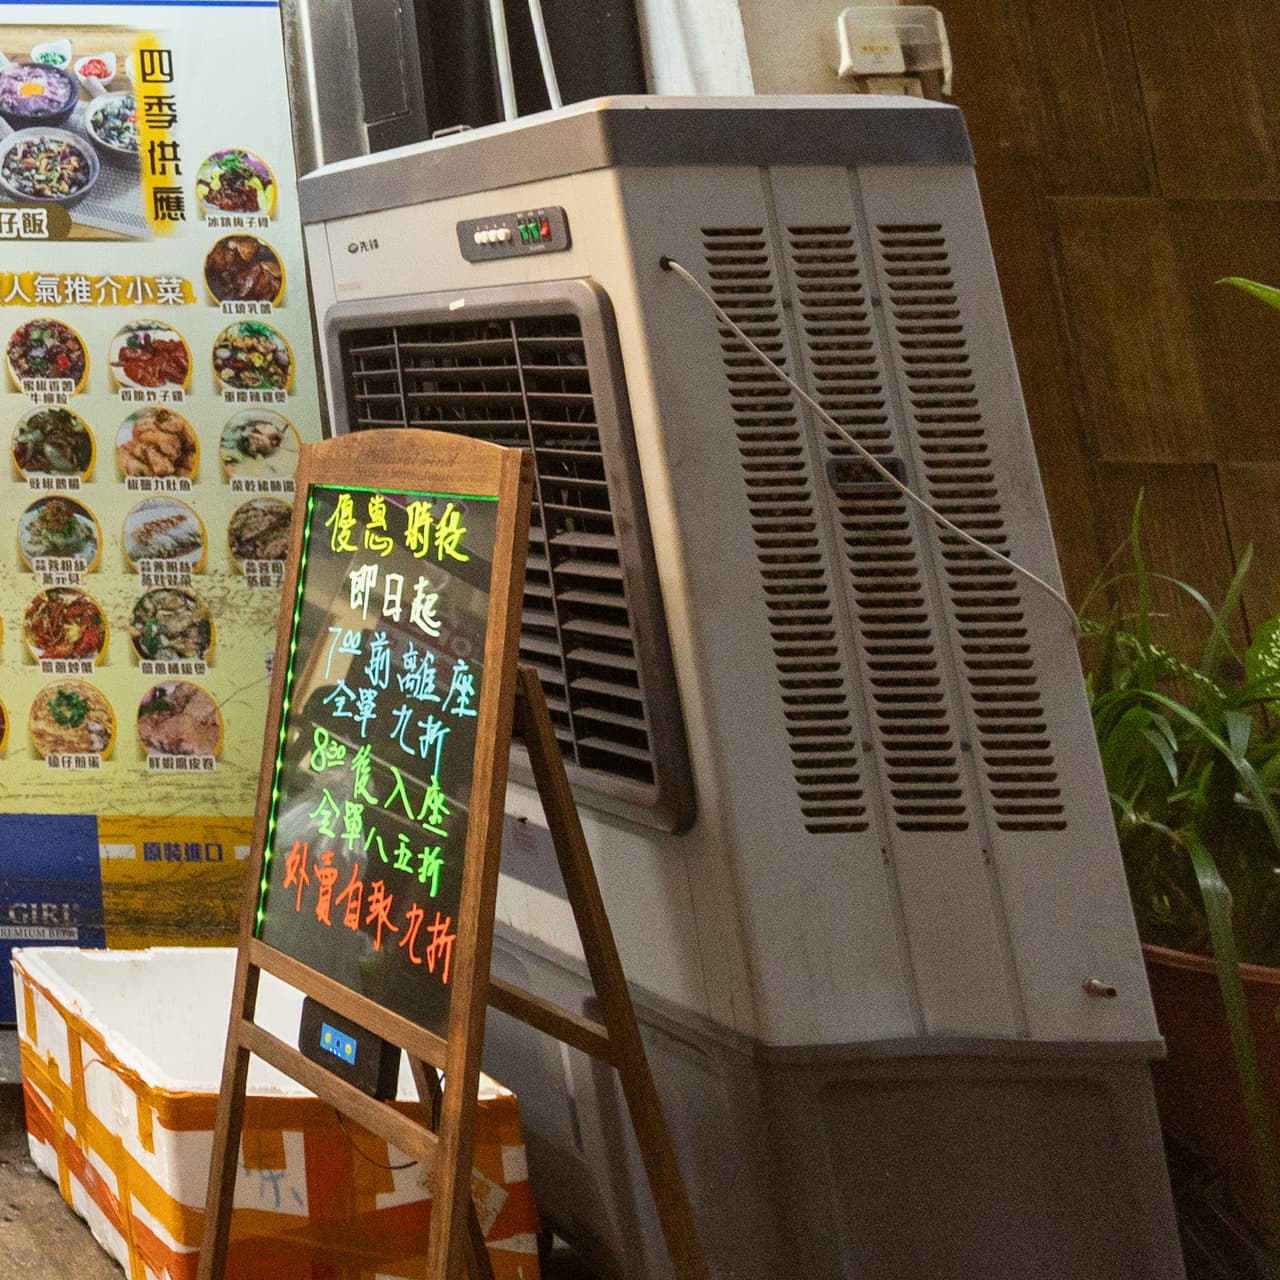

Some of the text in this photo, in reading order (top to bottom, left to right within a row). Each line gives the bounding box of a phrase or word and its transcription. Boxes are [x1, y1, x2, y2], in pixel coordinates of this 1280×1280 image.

[139, 49, 187, 223] 四季供應
[349, 564, 442, 638] 即日起
[142, 841, 224, 863] 原裝進口
[7, 903, 77, 925] GIRL
[282, 840, 457, 985] 外賣自取九折
